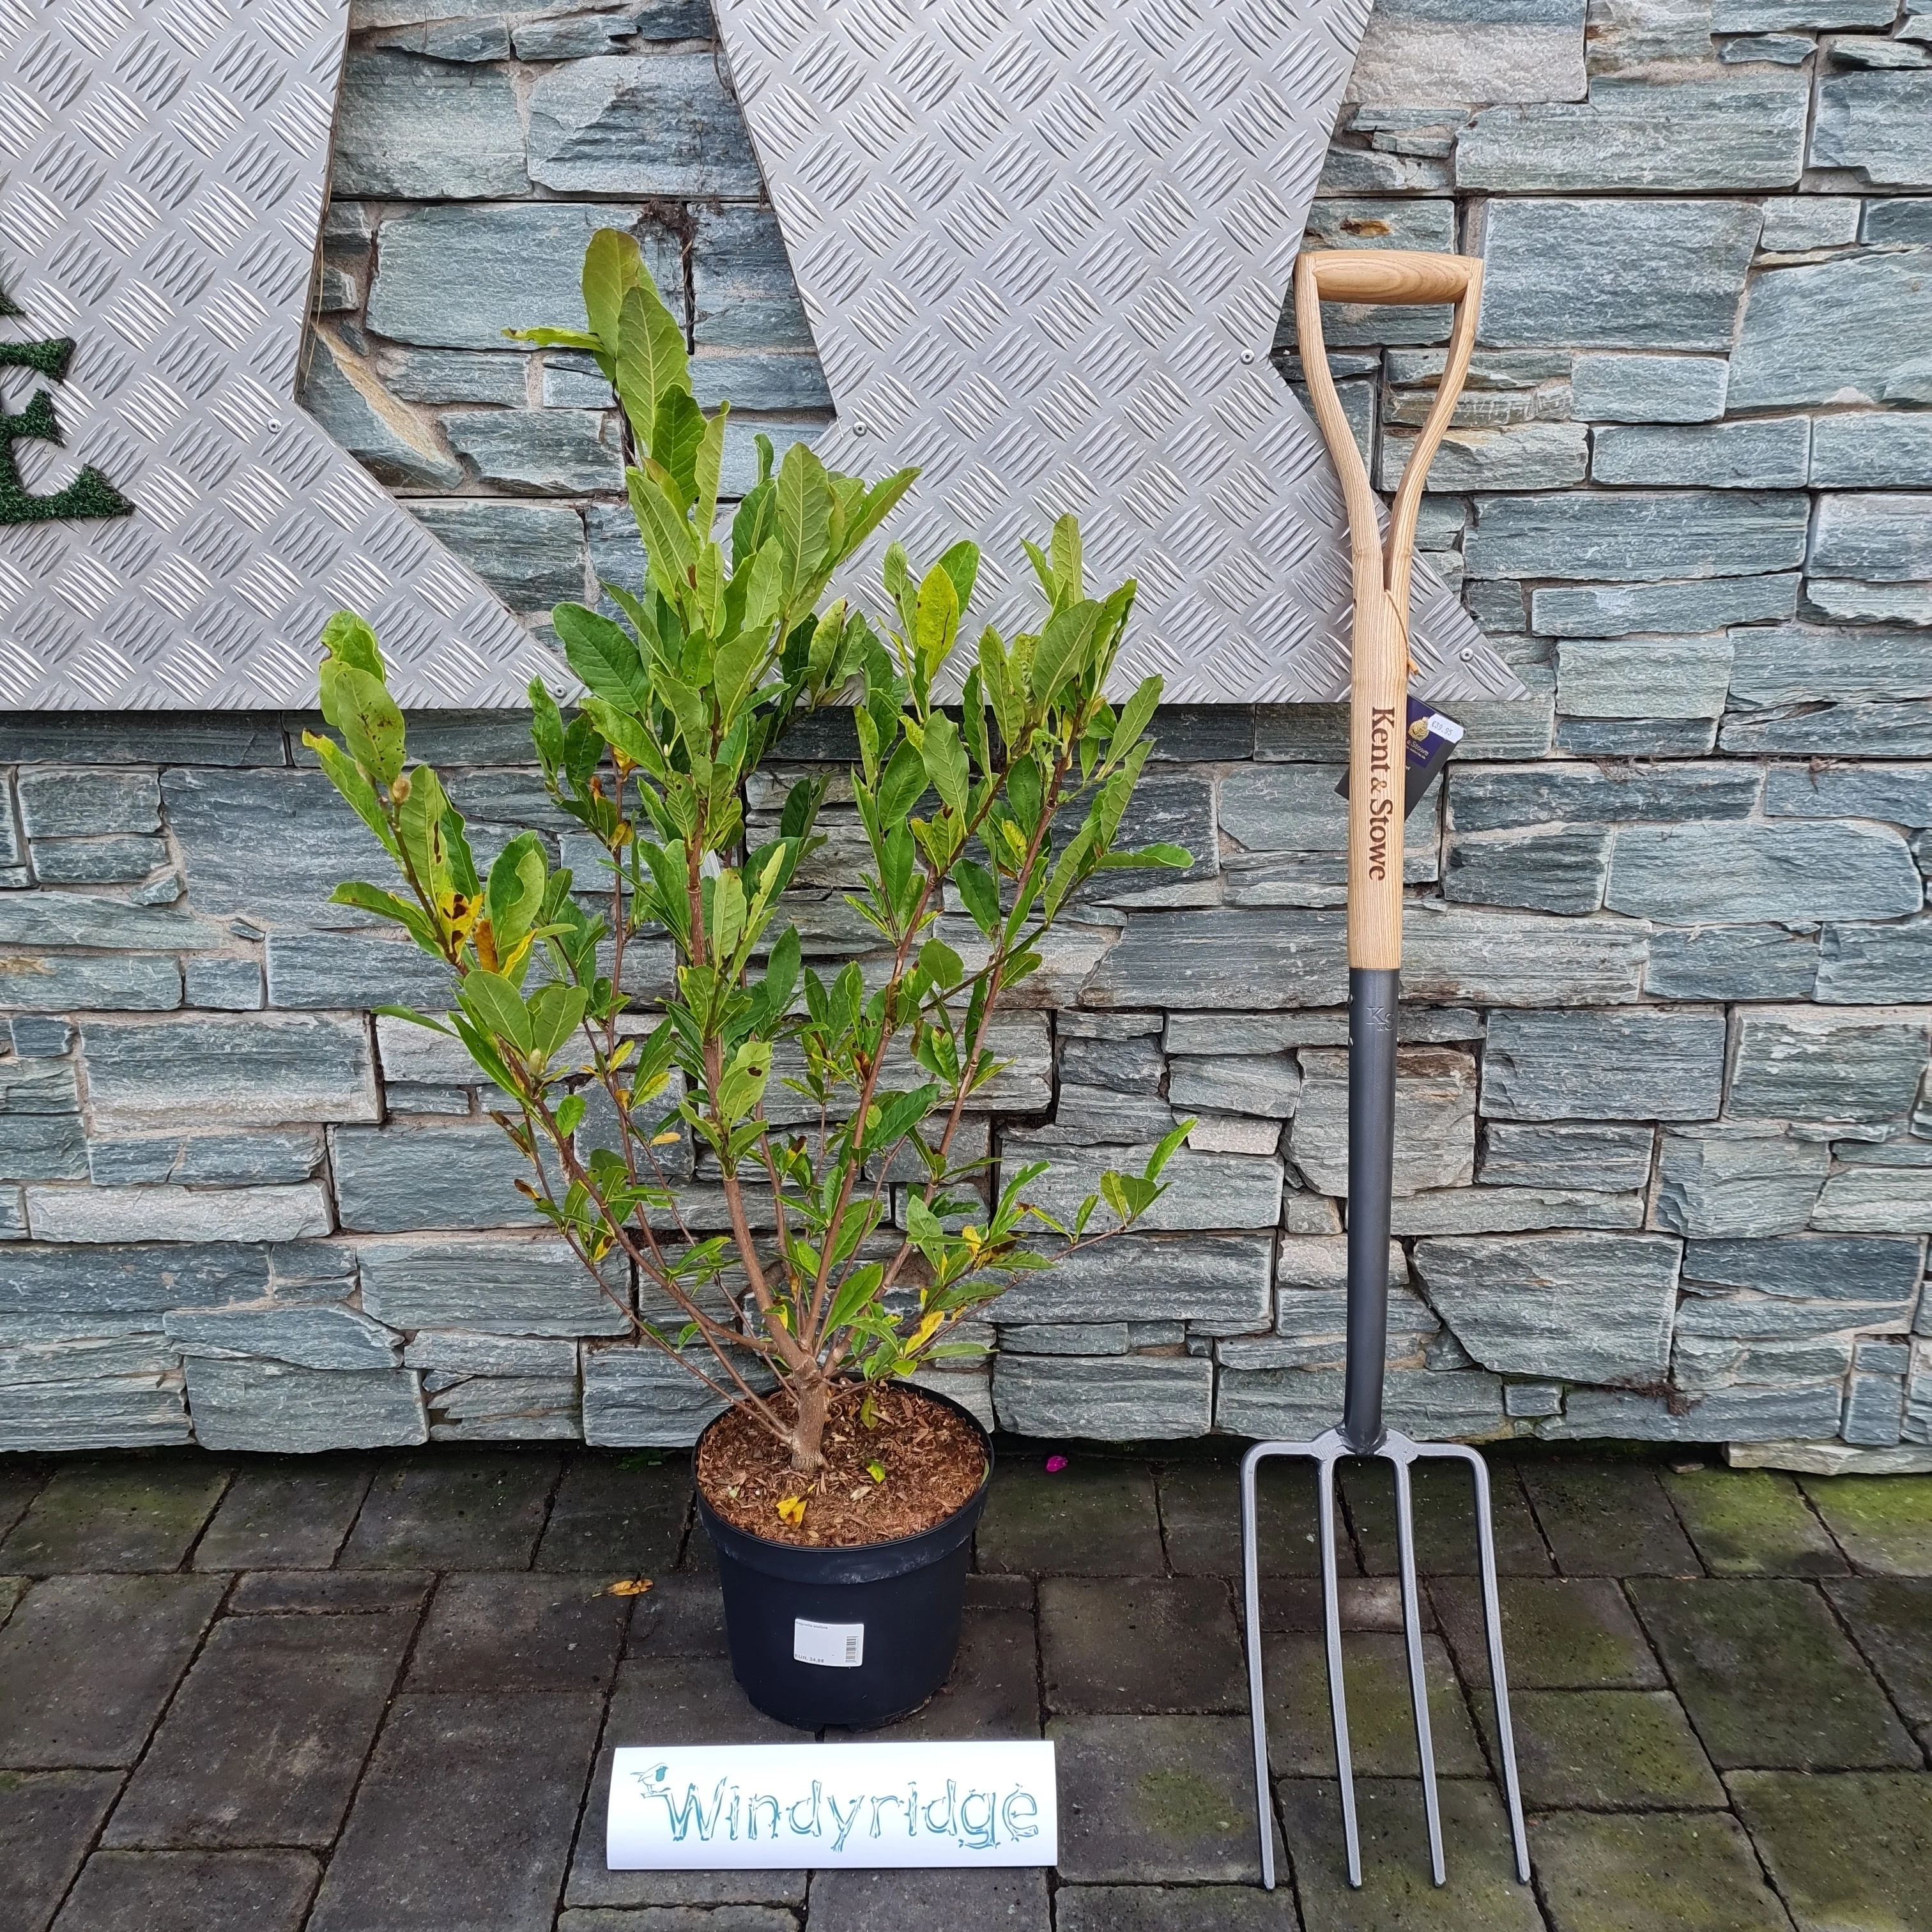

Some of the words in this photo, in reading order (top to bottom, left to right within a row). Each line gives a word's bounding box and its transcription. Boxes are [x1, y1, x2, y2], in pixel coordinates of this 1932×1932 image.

[1370, 706, 1395, 773] Kent
[1431, 720, 1453, 737] €39.95
[1370, 777, 1388, 794] &
[1368, 799, 1393, 882] Stowe
[641, 1776, 1039, 1853] Windyridge
